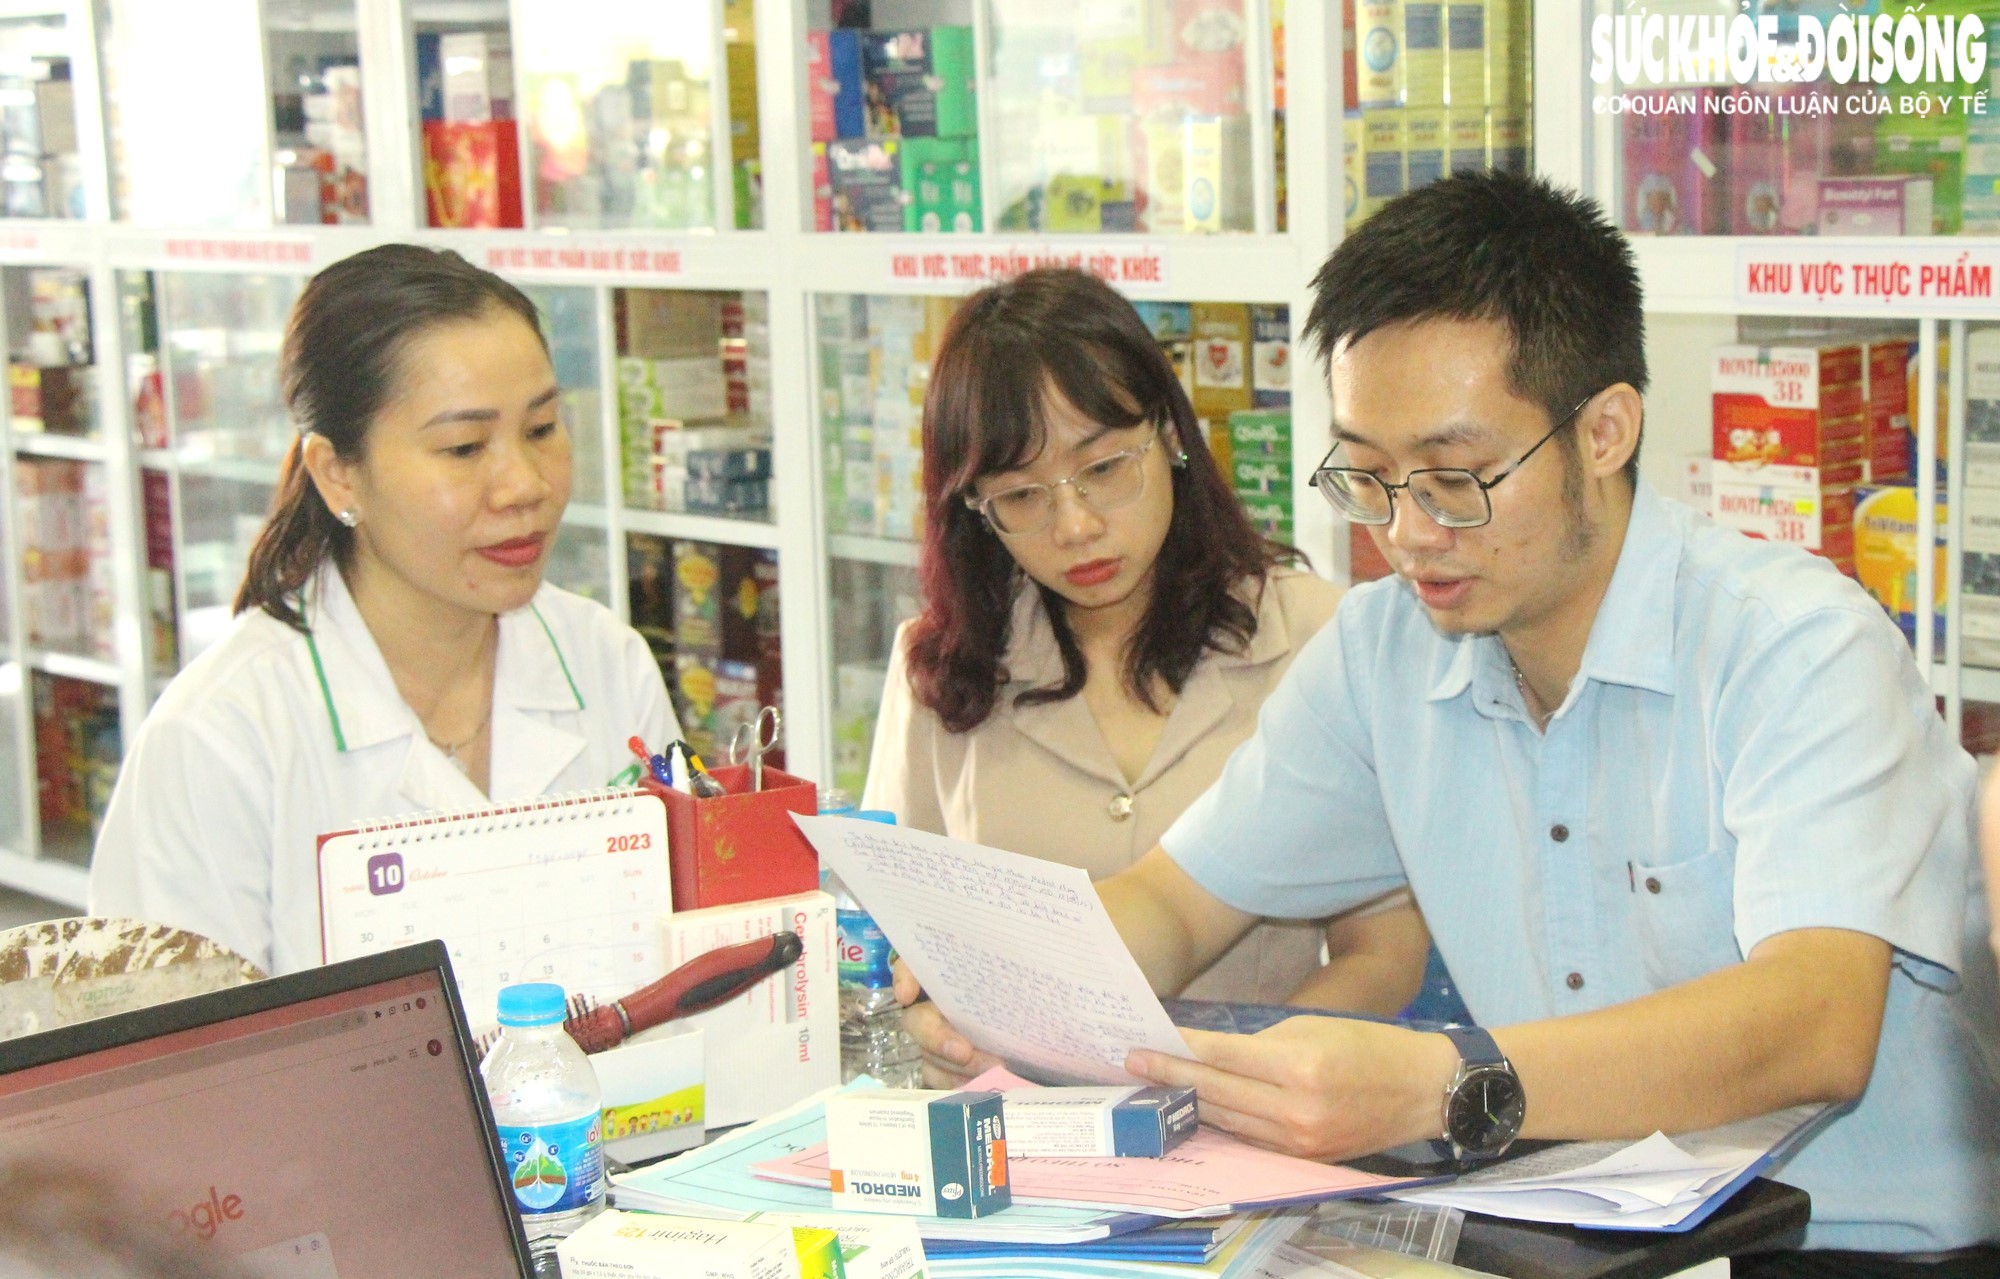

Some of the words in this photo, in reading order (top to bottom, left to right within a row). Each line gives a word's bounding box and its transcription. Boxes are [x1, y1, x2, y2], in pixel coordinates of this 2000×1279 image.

[1748, 263, 1792, 294] KHU
[1800, 261, 1843, 302] VỰC
[1852, 261, 1911, 303] THỰC
[1920, 251, 1992, 298] PHẨM
[606, 832, 652, 854] 2023
[374, 864, 402, 888] 10
[622, 869, 643, 879] SUN
[360, 932, 375, 944] 30
[403, 924, 416, 935] 31
[499, 941, 507, 952] 5
[543, 934, 551, 944] 6
[632, 922, 641, 932] 8
[498, 972, 510, 983] 12
[542, 965, 555, 976] 13
[632, 952, 645, 963] 15
[798, 1027, 811, 1063] 10ml
[976, 1127, 983, 1141] mg
[900, 1170, 914, 1181] mg
[914, 1172, 920, 1183] 4
[850, 1181, 921, 1198] MEDROL
[168, 1185, 246, 1242] ogle
[613, 1226, 648, 1239] 125
[647, 1229, 728, 1245] Haginir
